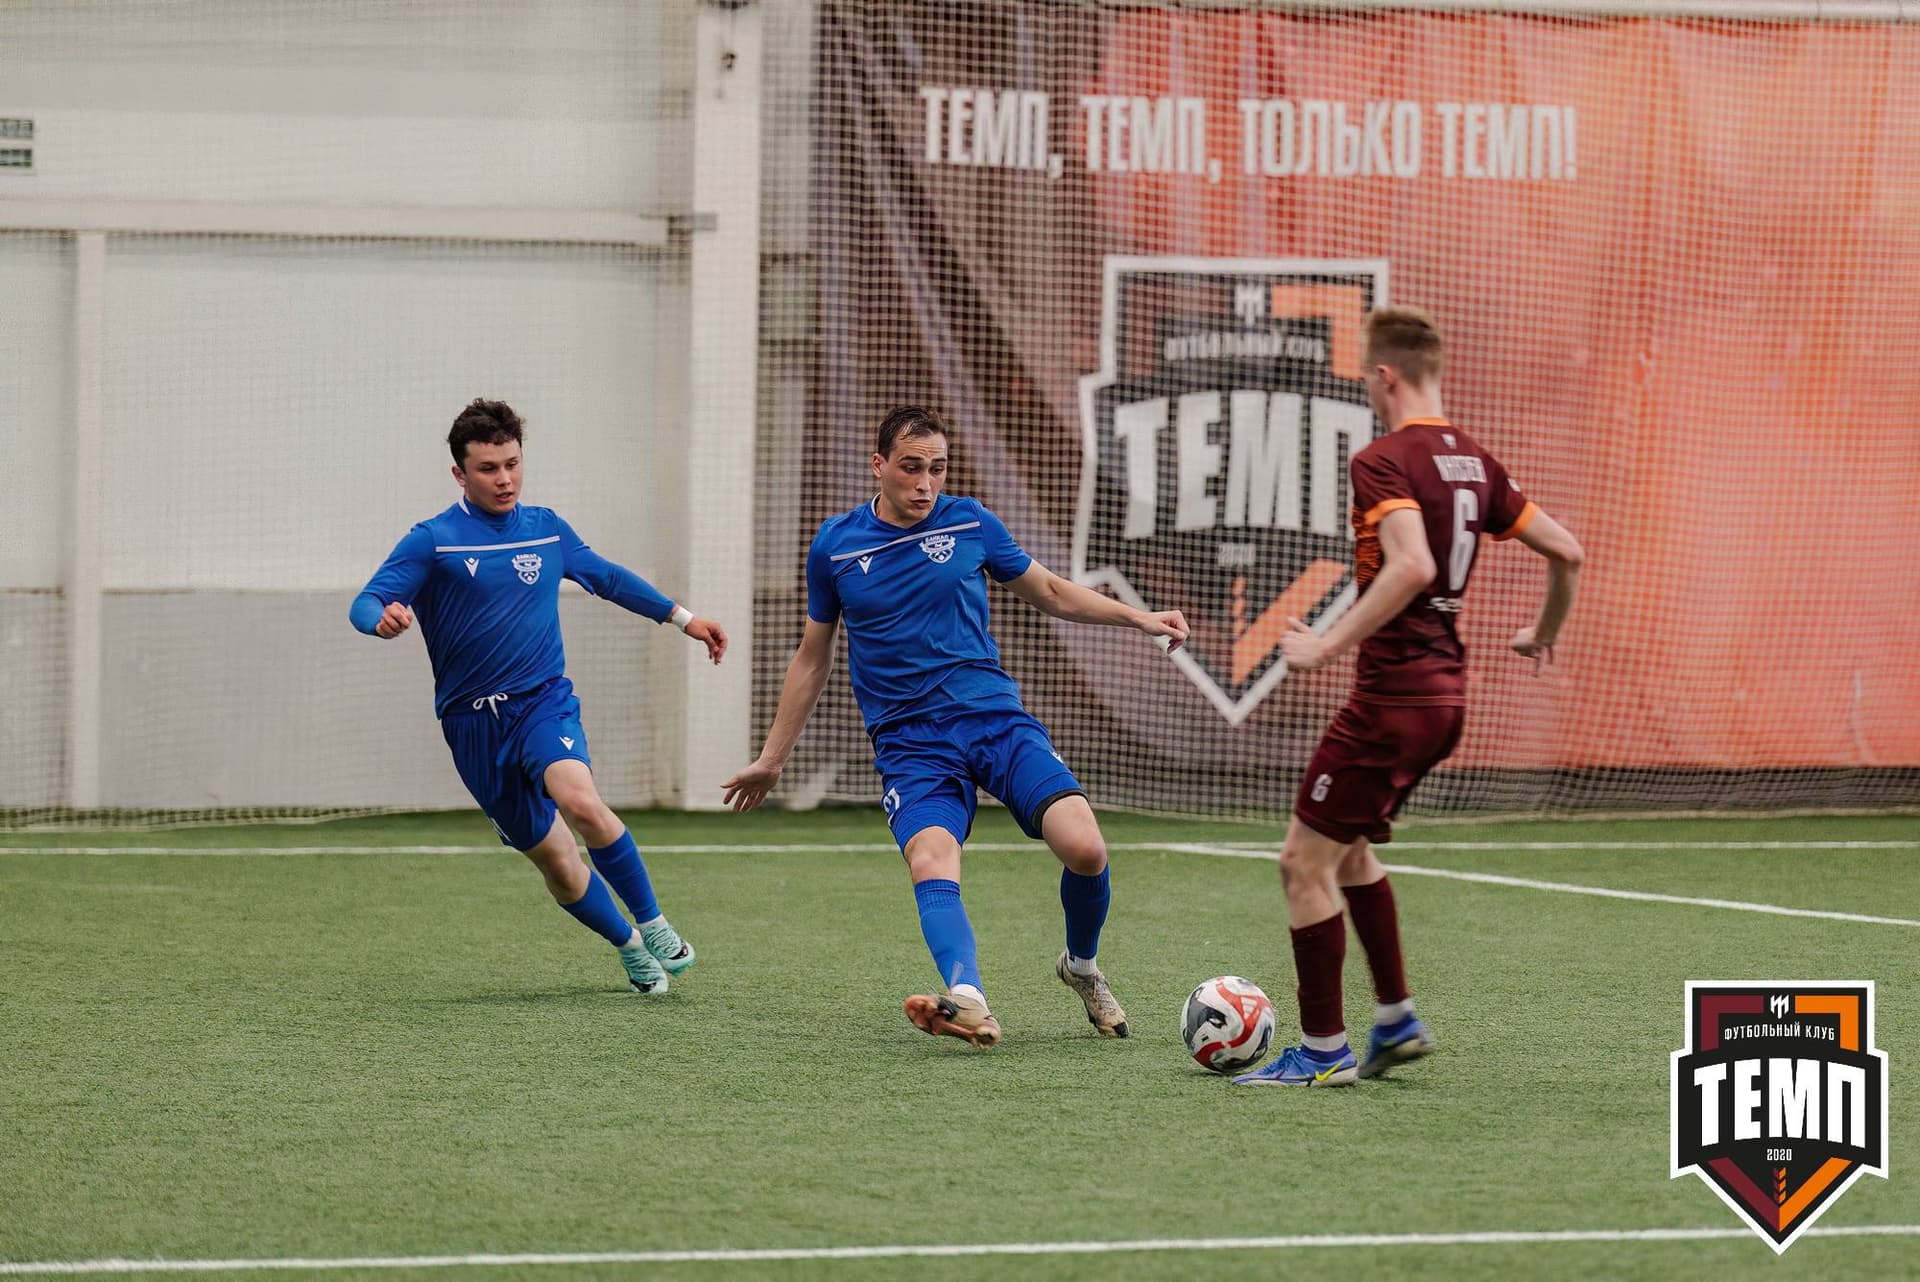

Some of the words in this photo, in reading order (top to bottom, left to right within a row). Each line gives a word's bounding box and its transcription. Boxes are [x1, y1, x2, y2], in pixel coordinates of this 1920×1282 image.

[920, 87, 1064, 179] ТЕМП,
[1081, 95, 1222, 184] ТЕМП,
[1238, 99, 1422, 178] ТОЛЬКО
[1434, 102, 1577, 179] ТЕМП!
[1114, 389, 1374, 540] ТЕМП
[1449, 488, 1479, 592] 6
[1310, 773, 1333, 802] 6
